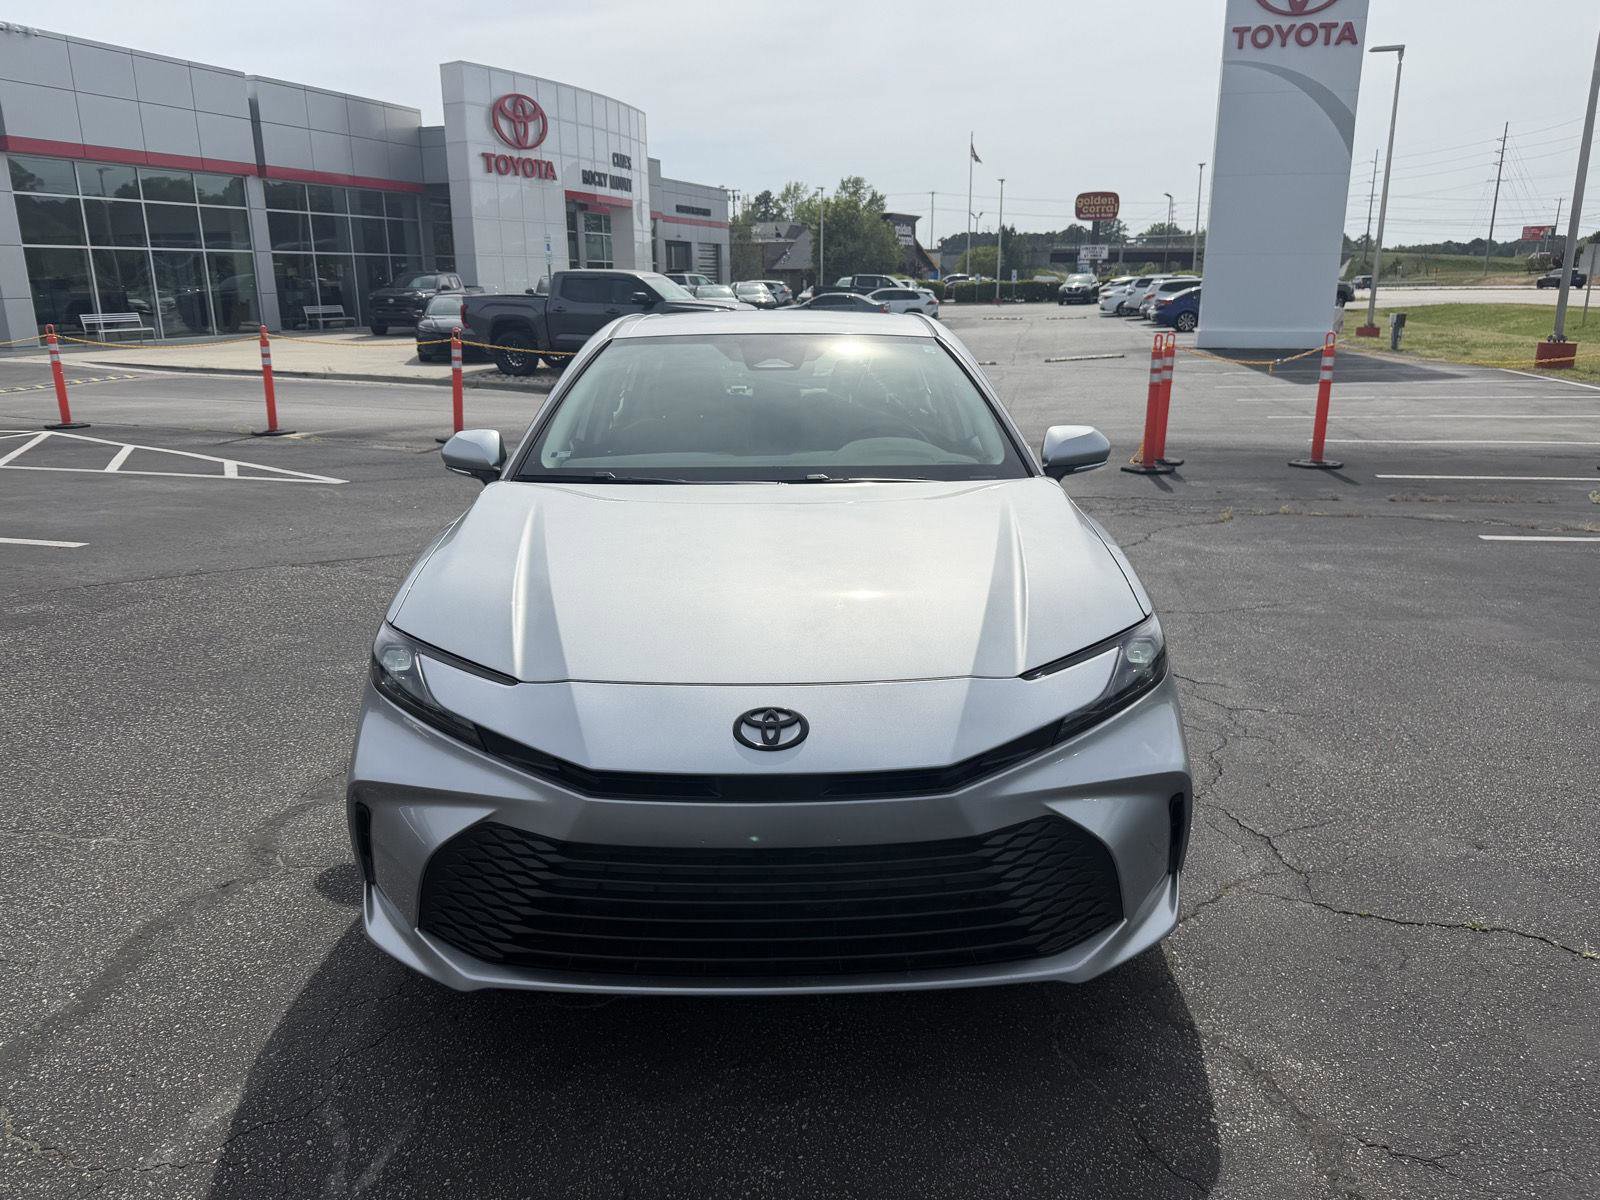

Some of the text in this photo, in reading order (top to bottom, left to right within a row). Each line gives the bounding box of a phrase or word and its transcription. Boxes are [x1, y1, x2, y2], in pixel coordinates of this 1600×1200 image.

[1232, 21, 1358, 50] TOYOTA
[481, 152, 558, 181] TOYOTA
[582, 169, 608, 188] ROCKY
[1077, 195, 1115, 208] golden
[1082, 203, 1118, 213] corral
